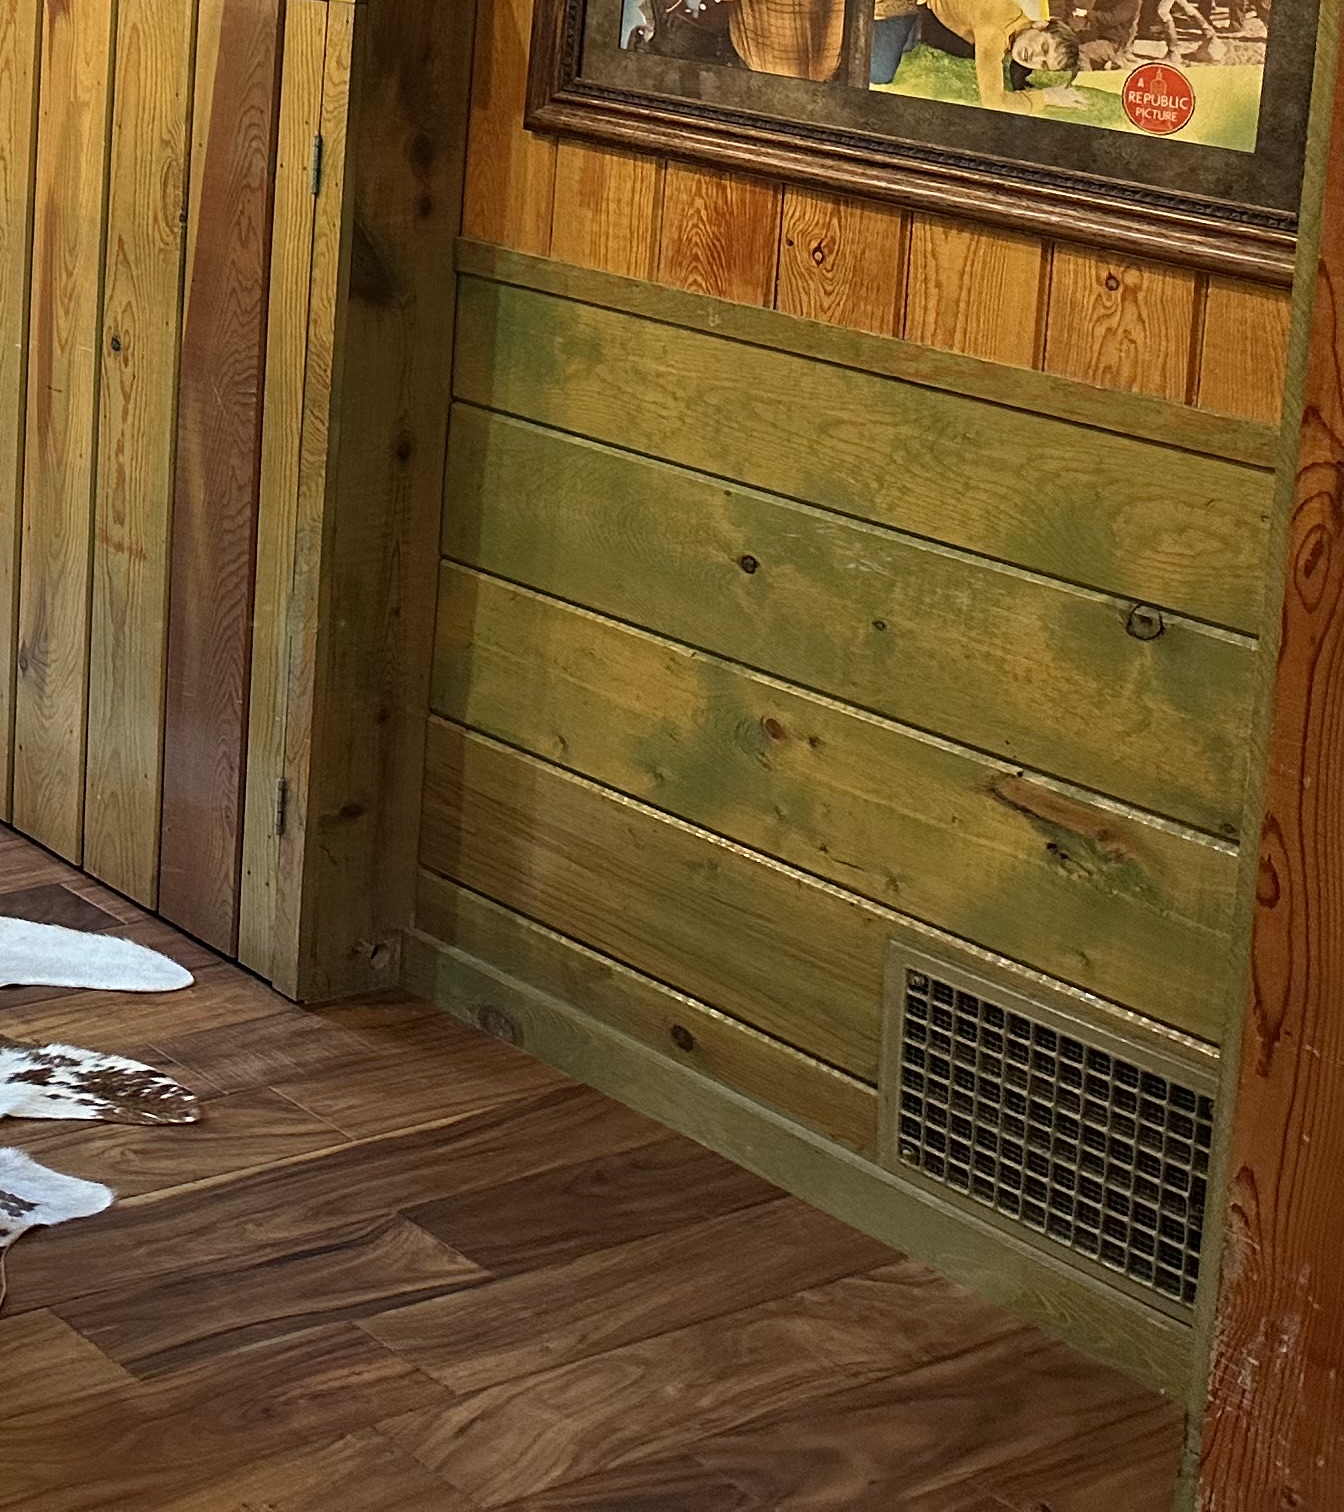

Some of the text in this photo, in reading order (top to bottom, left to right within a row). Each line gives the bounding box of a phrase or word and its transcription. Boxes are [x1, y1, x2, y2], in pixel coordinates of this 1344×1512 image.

[1137, 77, 1145, 88] A
[1128, 90, 1189, 110] REPUBLIC
[1135, 106, 1178, 123] PICTURE
